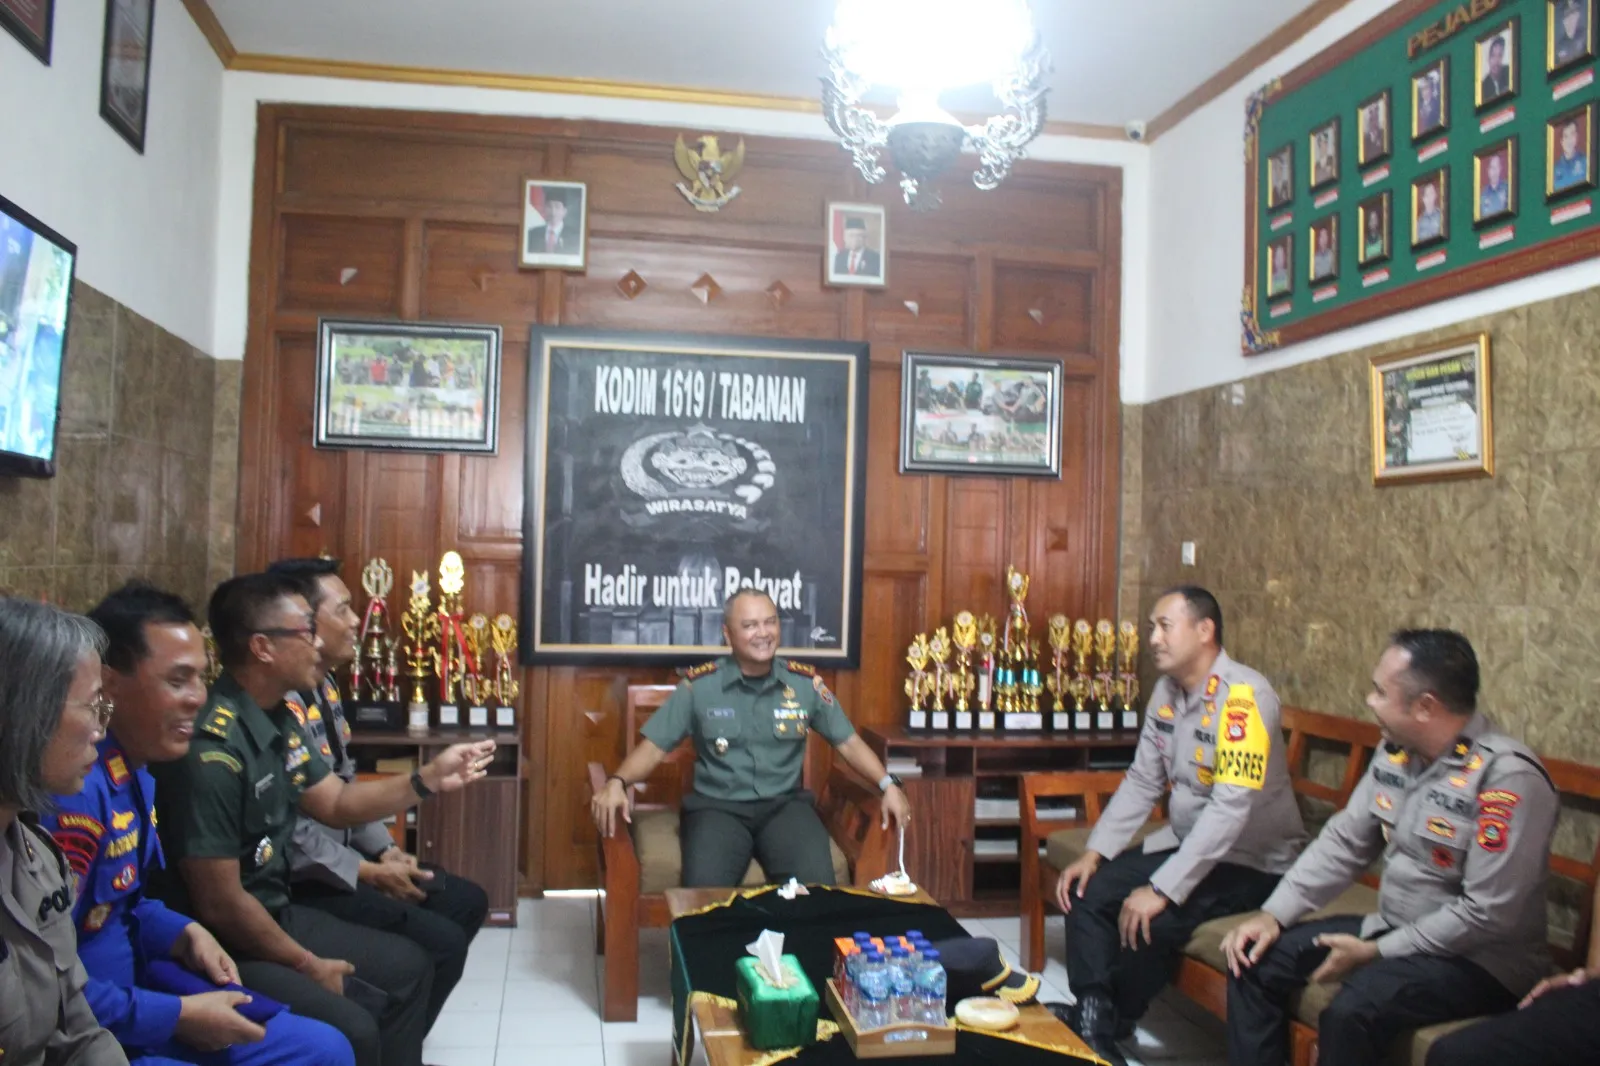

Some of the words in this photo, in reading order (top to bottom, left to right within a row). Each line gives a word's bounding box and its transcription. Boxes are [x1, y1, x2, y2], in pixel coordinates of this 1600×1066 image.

[595, 365, 657, 415] KODIM
[662, 369, 703, 418] 1619
[708, 371, 716, 419] /
[719, 373, 806, 423] TABANAN
[645, 498, 748, 520] WIRASATYA
[585, 563, 648, 606] Hadir
[653, 566, 718, 608] untuk
[1214, 749, 1264, 781] OPSRES
